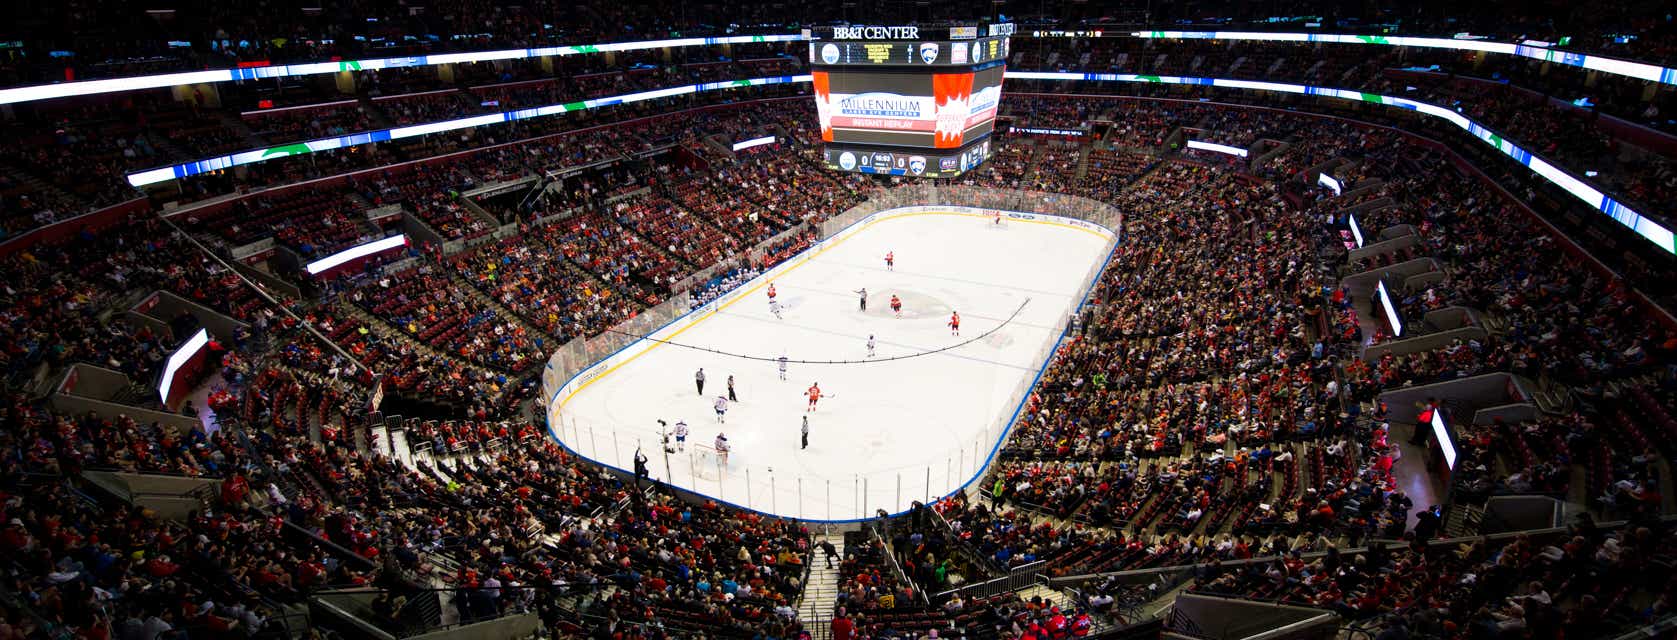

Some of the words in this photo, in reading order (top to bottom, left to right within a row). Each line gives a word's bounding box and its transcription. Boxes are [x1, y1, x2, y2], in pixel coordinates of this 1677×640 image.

[833, 26, 864, 39] BB&T
[864, 26, 919, 39] CENTER
[841, 98, 920, 111] MILLENNIUM
[861, 155, 868, 165] 0
[898, 158, 905, 167] 0
